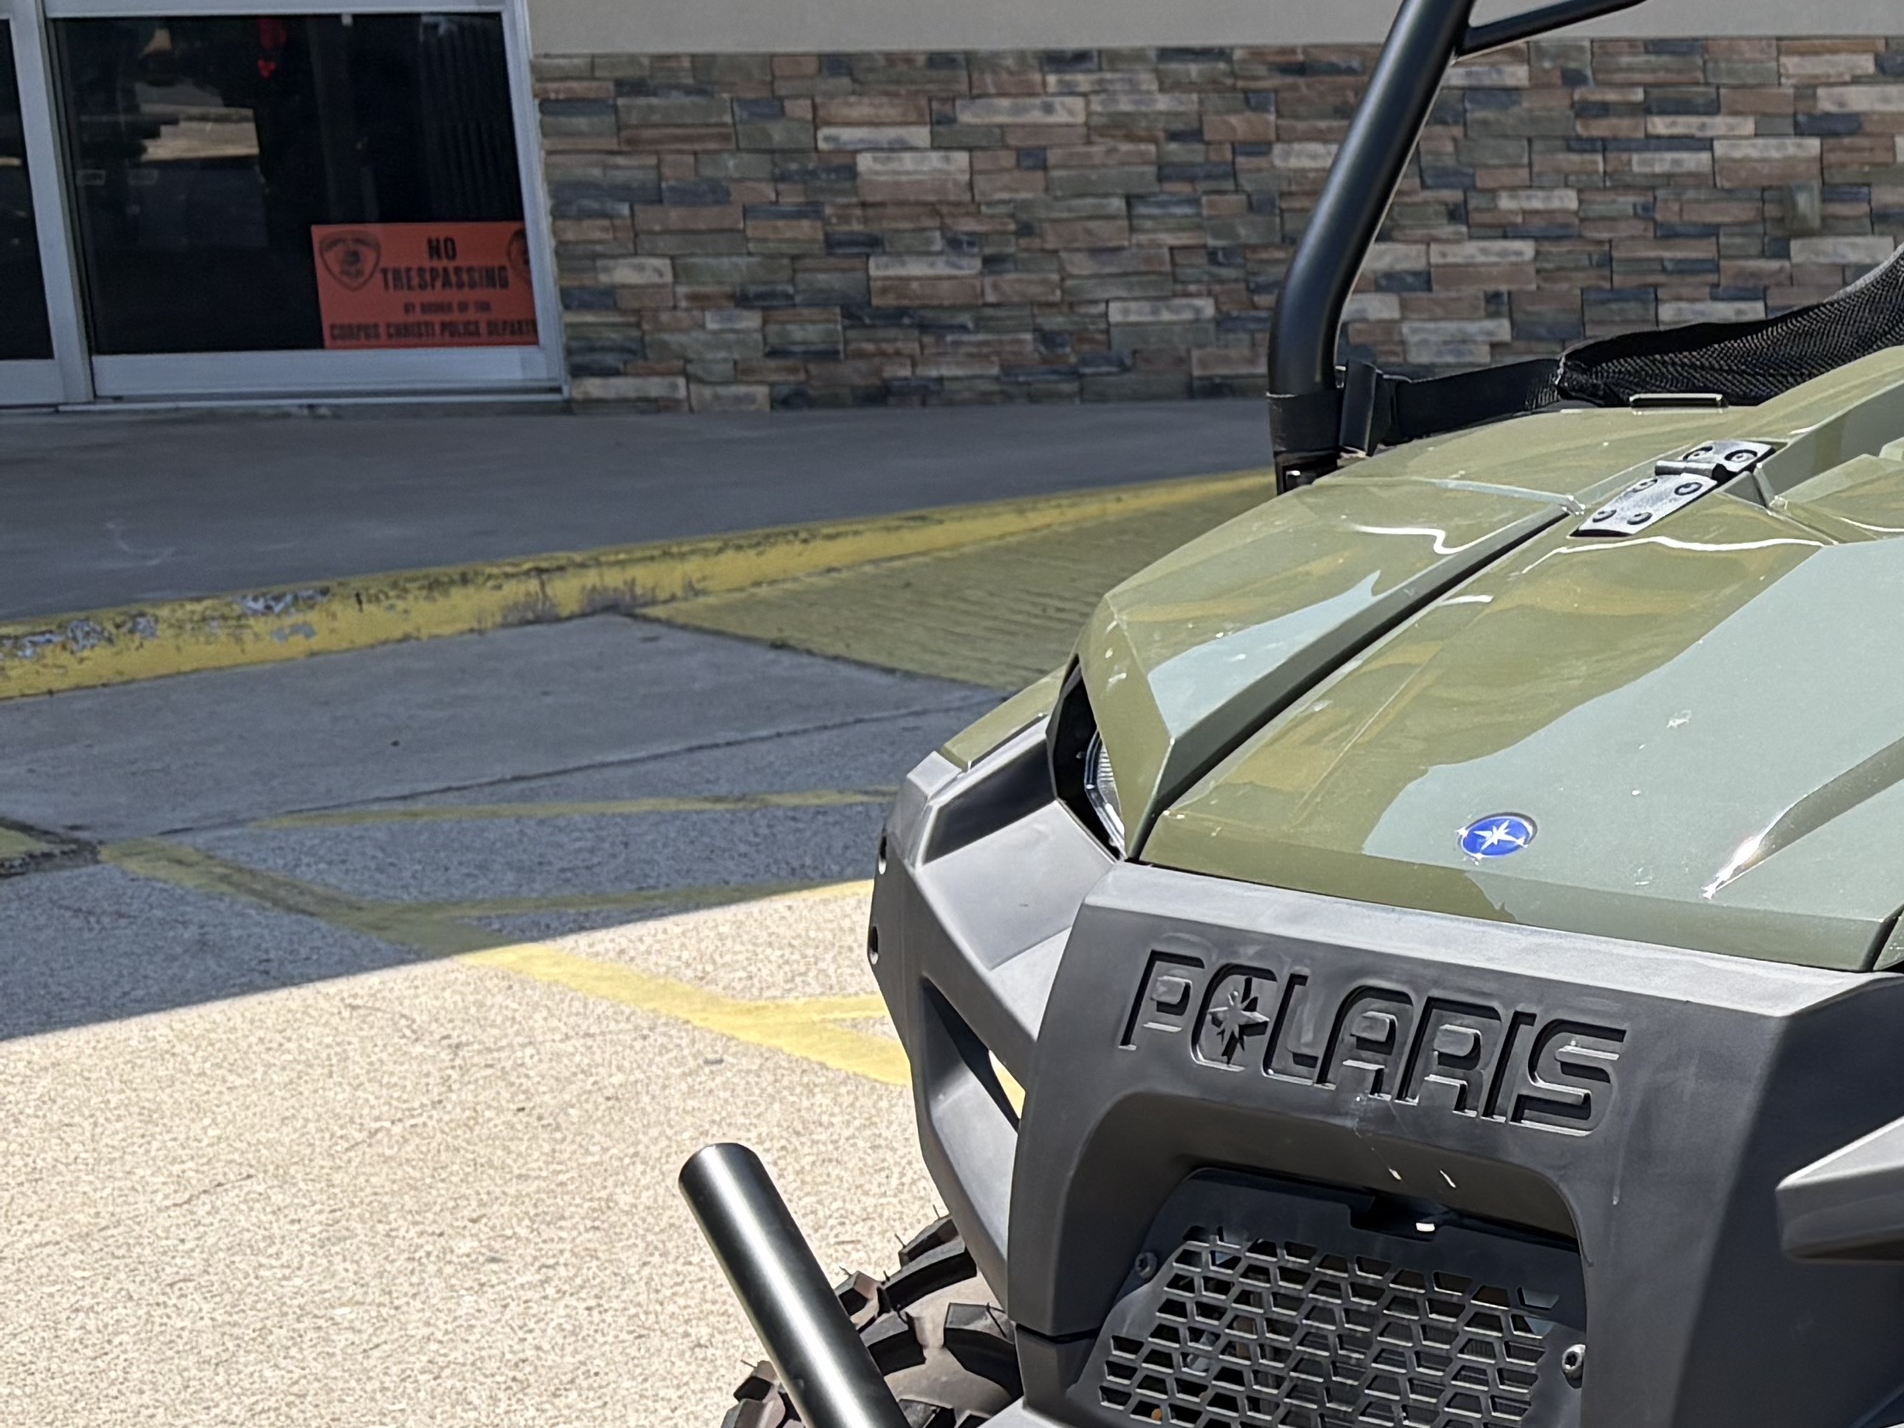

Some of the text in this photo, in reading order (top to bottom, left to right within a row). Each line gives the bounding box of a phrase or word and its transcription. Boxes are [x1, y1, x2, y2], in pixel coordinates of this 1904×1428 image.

[427, 236, 458, 261] NO
[380, 265, 510, 292] TRESPASSING
[1118, 948, 1627, 1137] POLARIS
